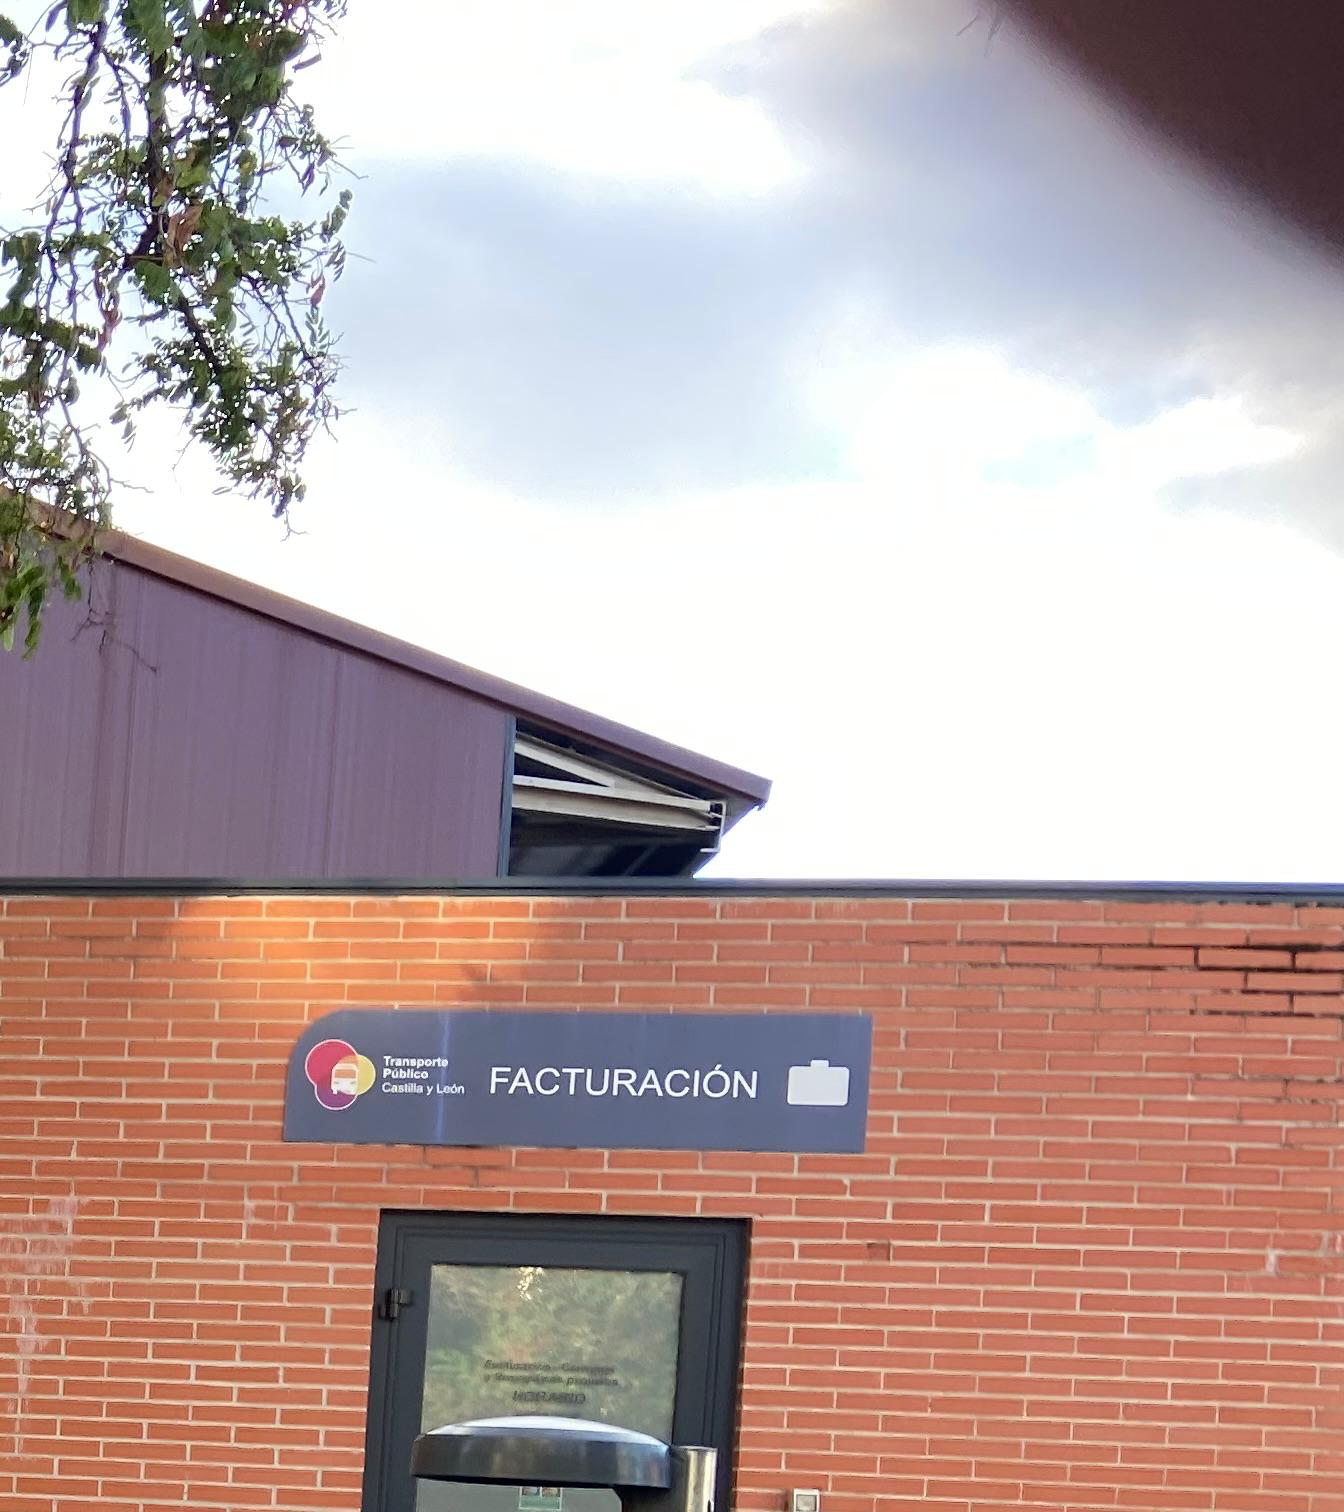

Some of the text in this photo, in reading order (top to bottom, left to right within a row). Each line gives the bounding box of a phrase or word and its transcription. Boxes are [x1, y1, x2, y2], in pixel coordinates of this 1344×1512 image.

[383, 1055, 449, 1069] Transporte
[383, 1067, 429, 1079] Público
[489, 1063, 758, 1099] FACTURACIÓN
[382, 1082, 465, 1096] Castilla y León
